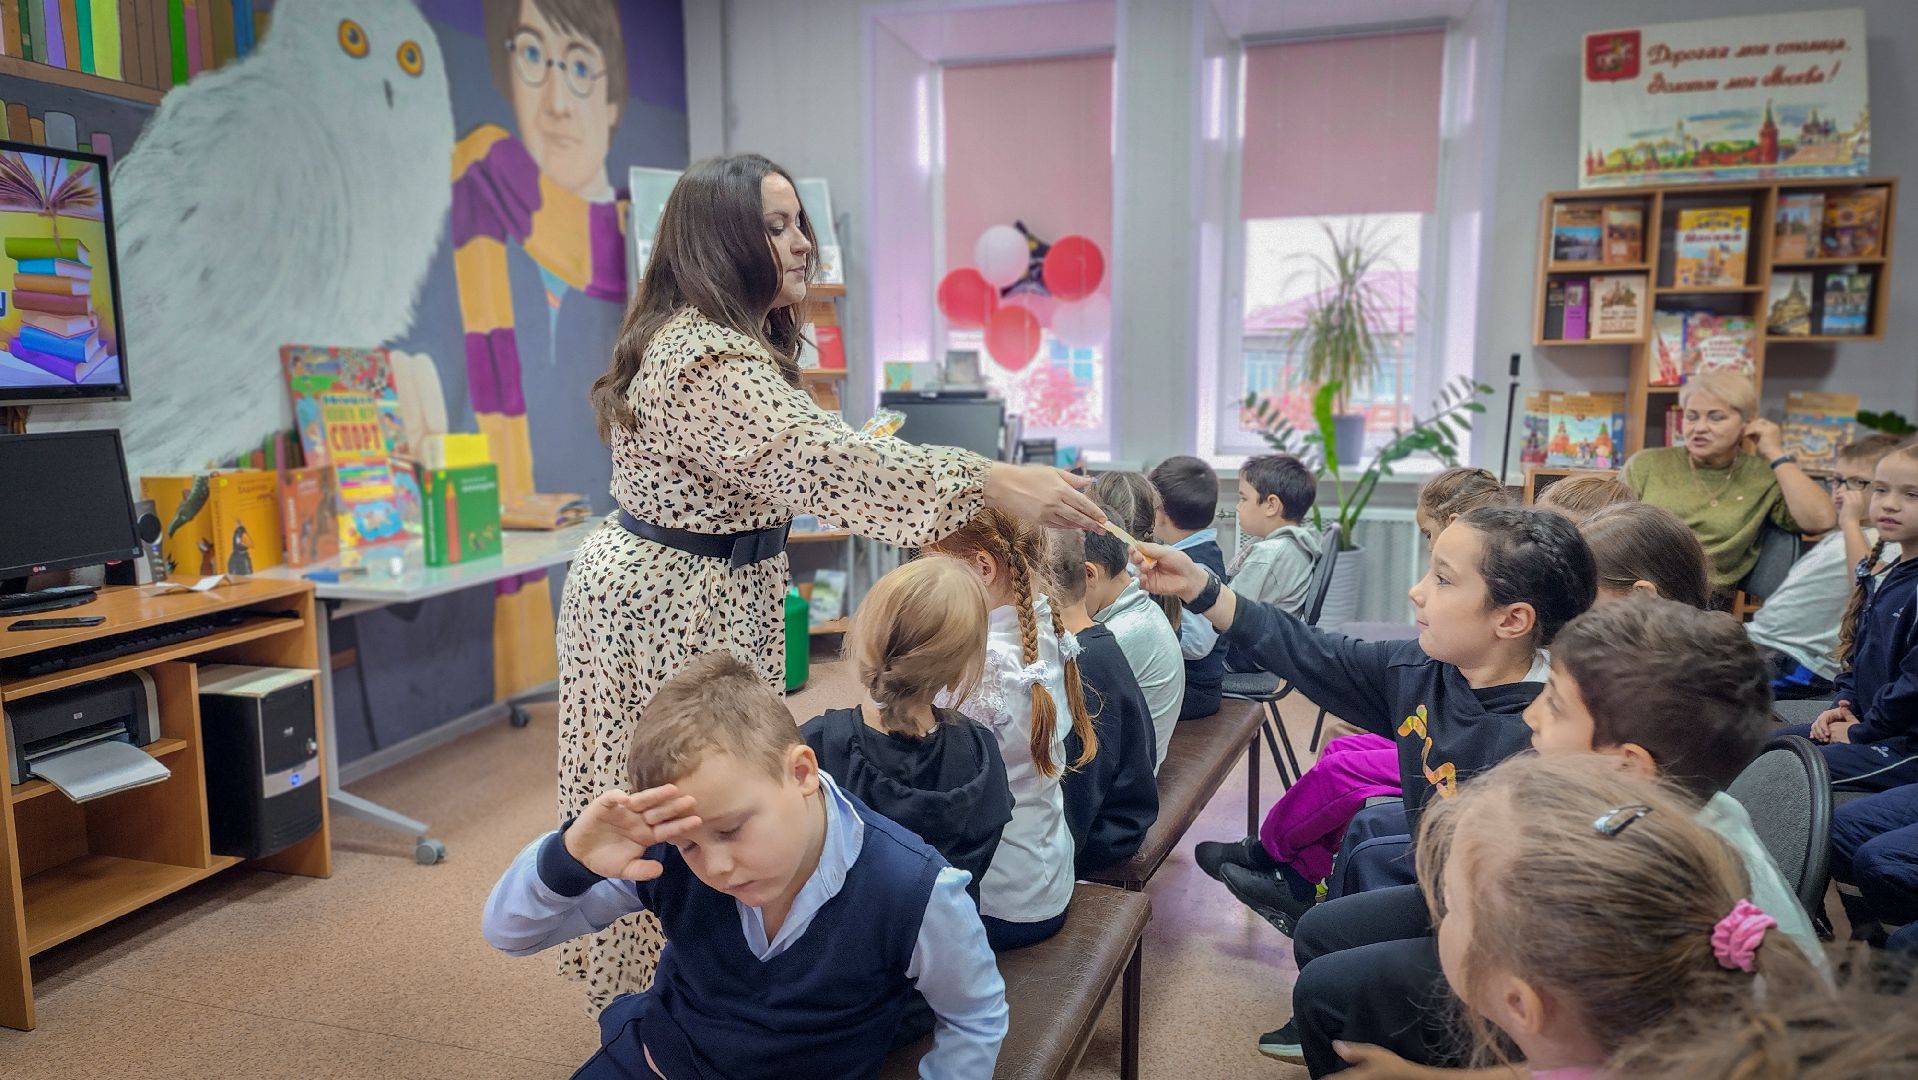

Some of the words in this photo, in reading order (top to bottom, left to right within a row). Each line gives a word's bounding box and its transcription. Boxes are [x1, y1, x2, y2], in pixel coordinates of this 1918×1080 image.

[1647, 43, 1729, 68] Дорогая
[1735, 44, 1769, 58] моя
[329, 423, 381, 451] СПОРТ
